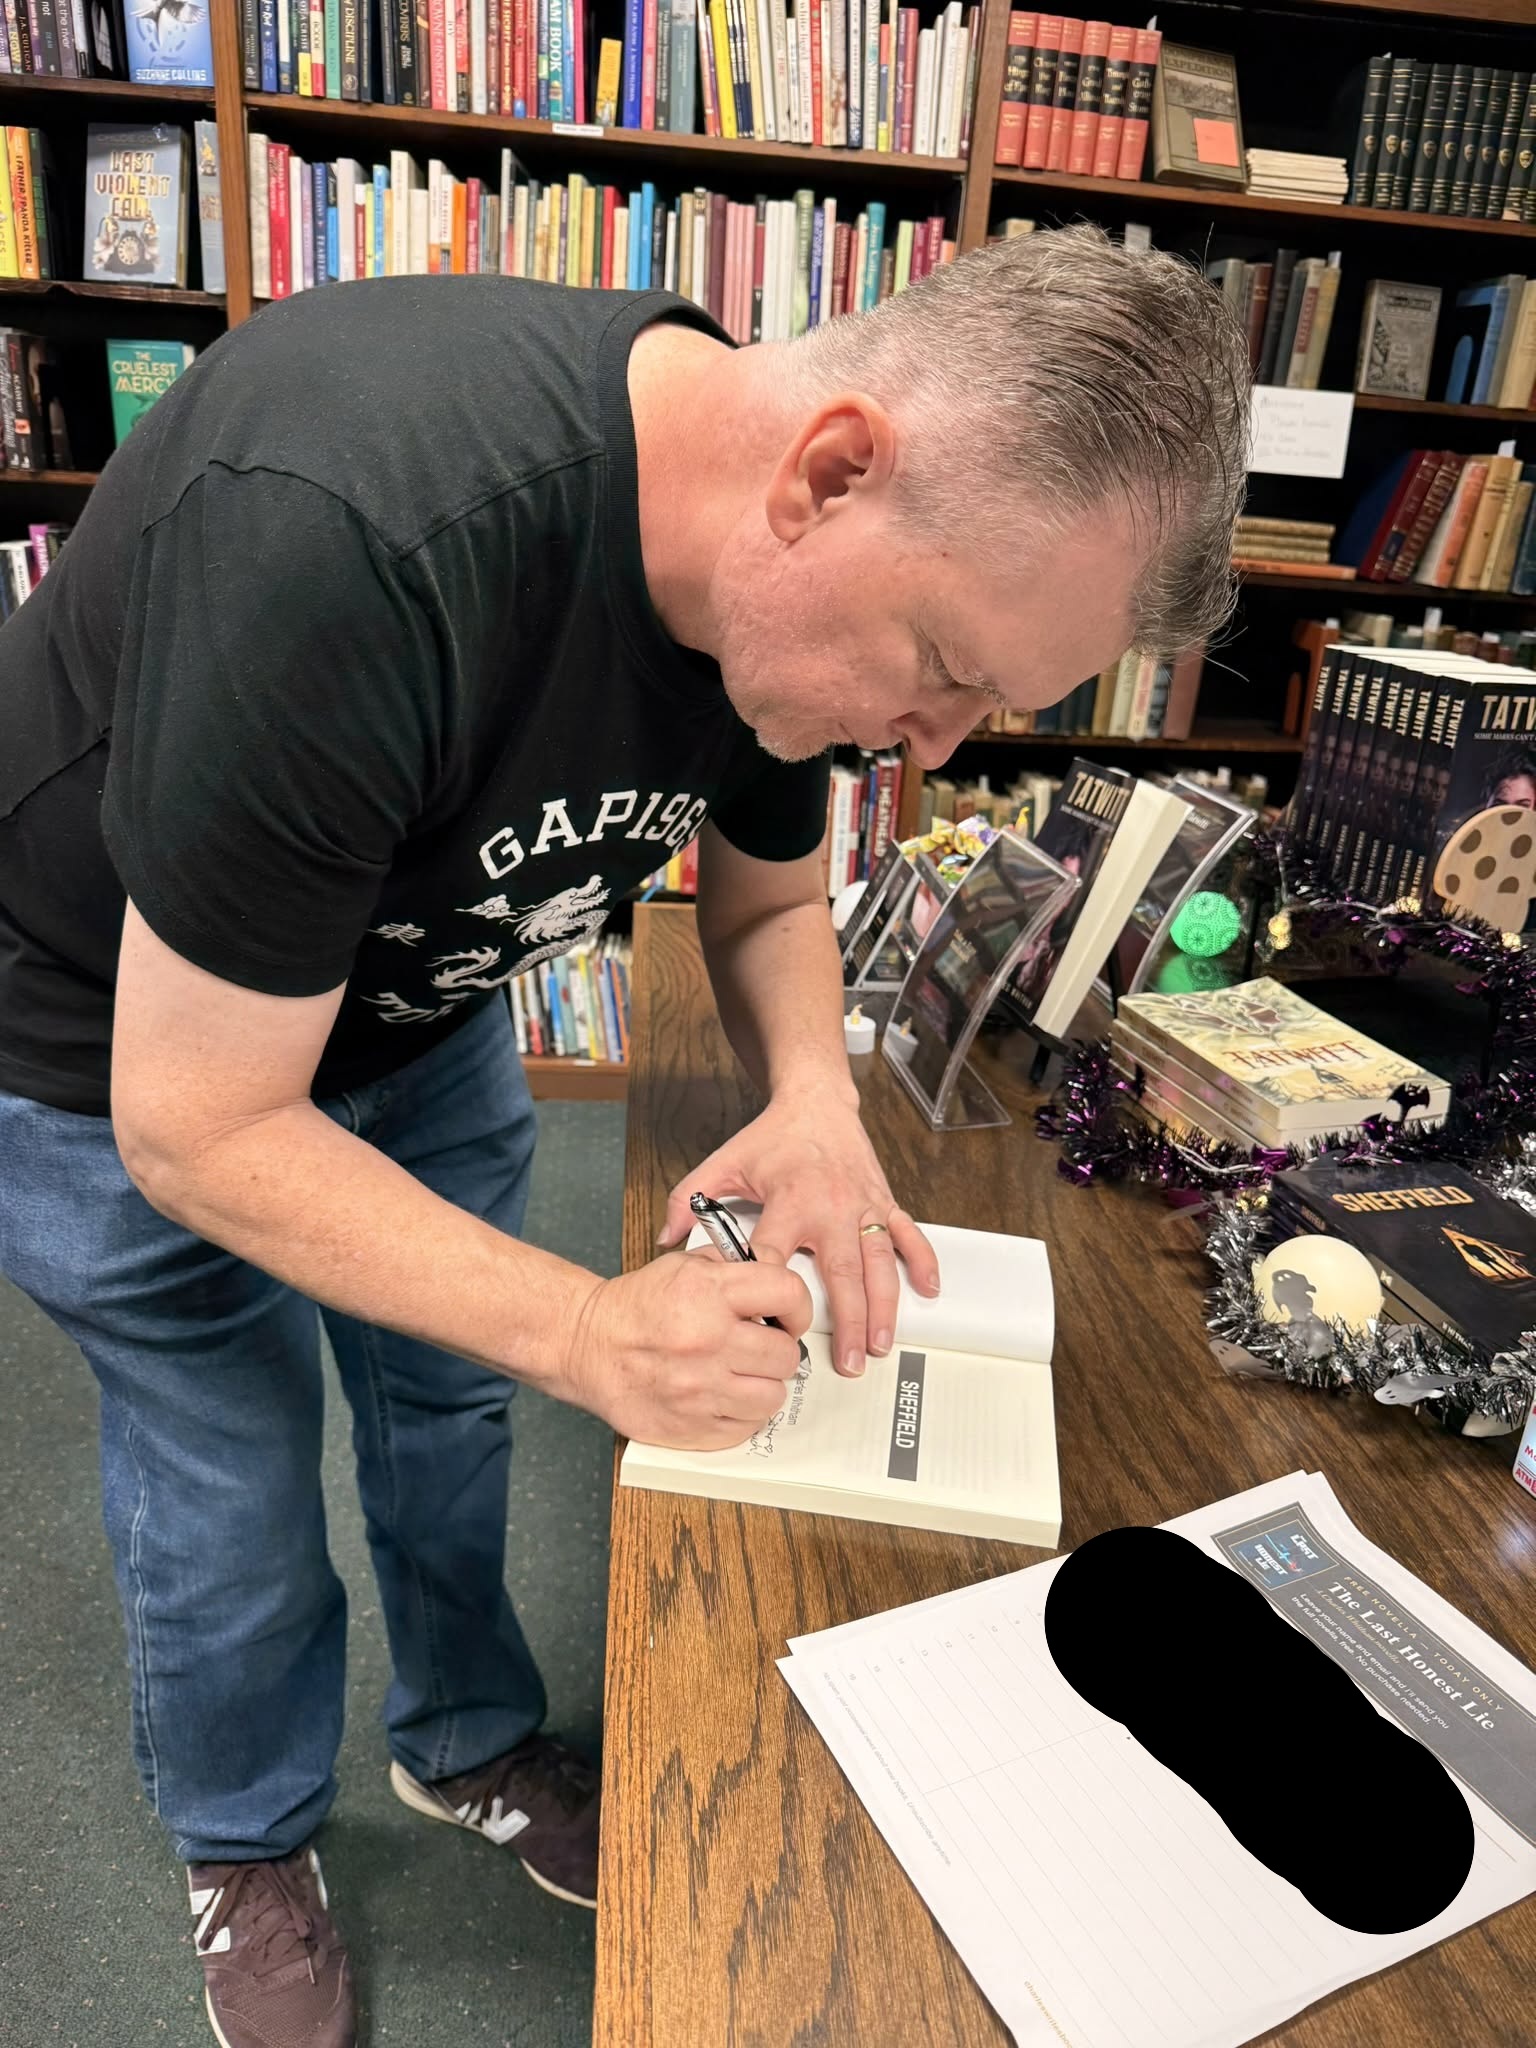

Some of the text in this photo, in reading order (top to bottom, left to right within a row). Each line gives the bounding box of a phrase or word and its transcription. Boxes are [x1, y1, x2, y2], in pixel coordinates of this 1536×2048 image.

[345, 8, 355, 64] DISCIPLINE
[550, 27, 562, 72] BOOK
[94, 173, 171, 198] VIOLENT
[112, 360, 178, 377] CRUELEST
[115, 376, 175, 394] MERCY
[1313, 665, 1330, 712] TATWITT
[1332, 668, 1348, 716] TATWITT
[1348, 673, 1366, 720] TATWITT
[1364, 676, 1384, 724] TATWITT
[1382, 680, 1402, 730] TATWITT
[1396, 687, 1415, 736] TATWITT
[1412, 690, 1432, 740] TATWITT
[1430, 694, 1450, 744] TATWITT
[1444, 698, 1465, 749] TATWITT
[874, 786, 892, 858] MEATHEAD
[1222, 1040, 1371, 1070] TATWITT
[1332, 1185, 1475, 1213] SHEFFIELD
[787, 1396, 803, 1426] Whitham
[896, 1380, 920, 1449] SHEFFIELD
[1291, 1596, 1430, 1724] the full novella, free. No purchase needed.
[1300, 1594, 1322, 1613] Leave
[1318, 1612, 1338, 1628] your
[1336, 1626, 1356, 1645] name
[1355, 1641, 1372, 1657] and
[1370, 1656, 1392, 1676] email
[1390, 1674, 1407, 1689] and
[1414, 1697, 1436, 1715] send
[1432, 1714, 1449, 1730] you
[1328, 1582, 1494, 1730] The Last Honest Lie
[1344, 1576, 1370, 1596] FREE
[1372, 1598, 1417, 1639] NOVELLA
[1434, 1652, 1470, 1682] TODAY
[1472, 1686, 1504, 1711] ONLY
